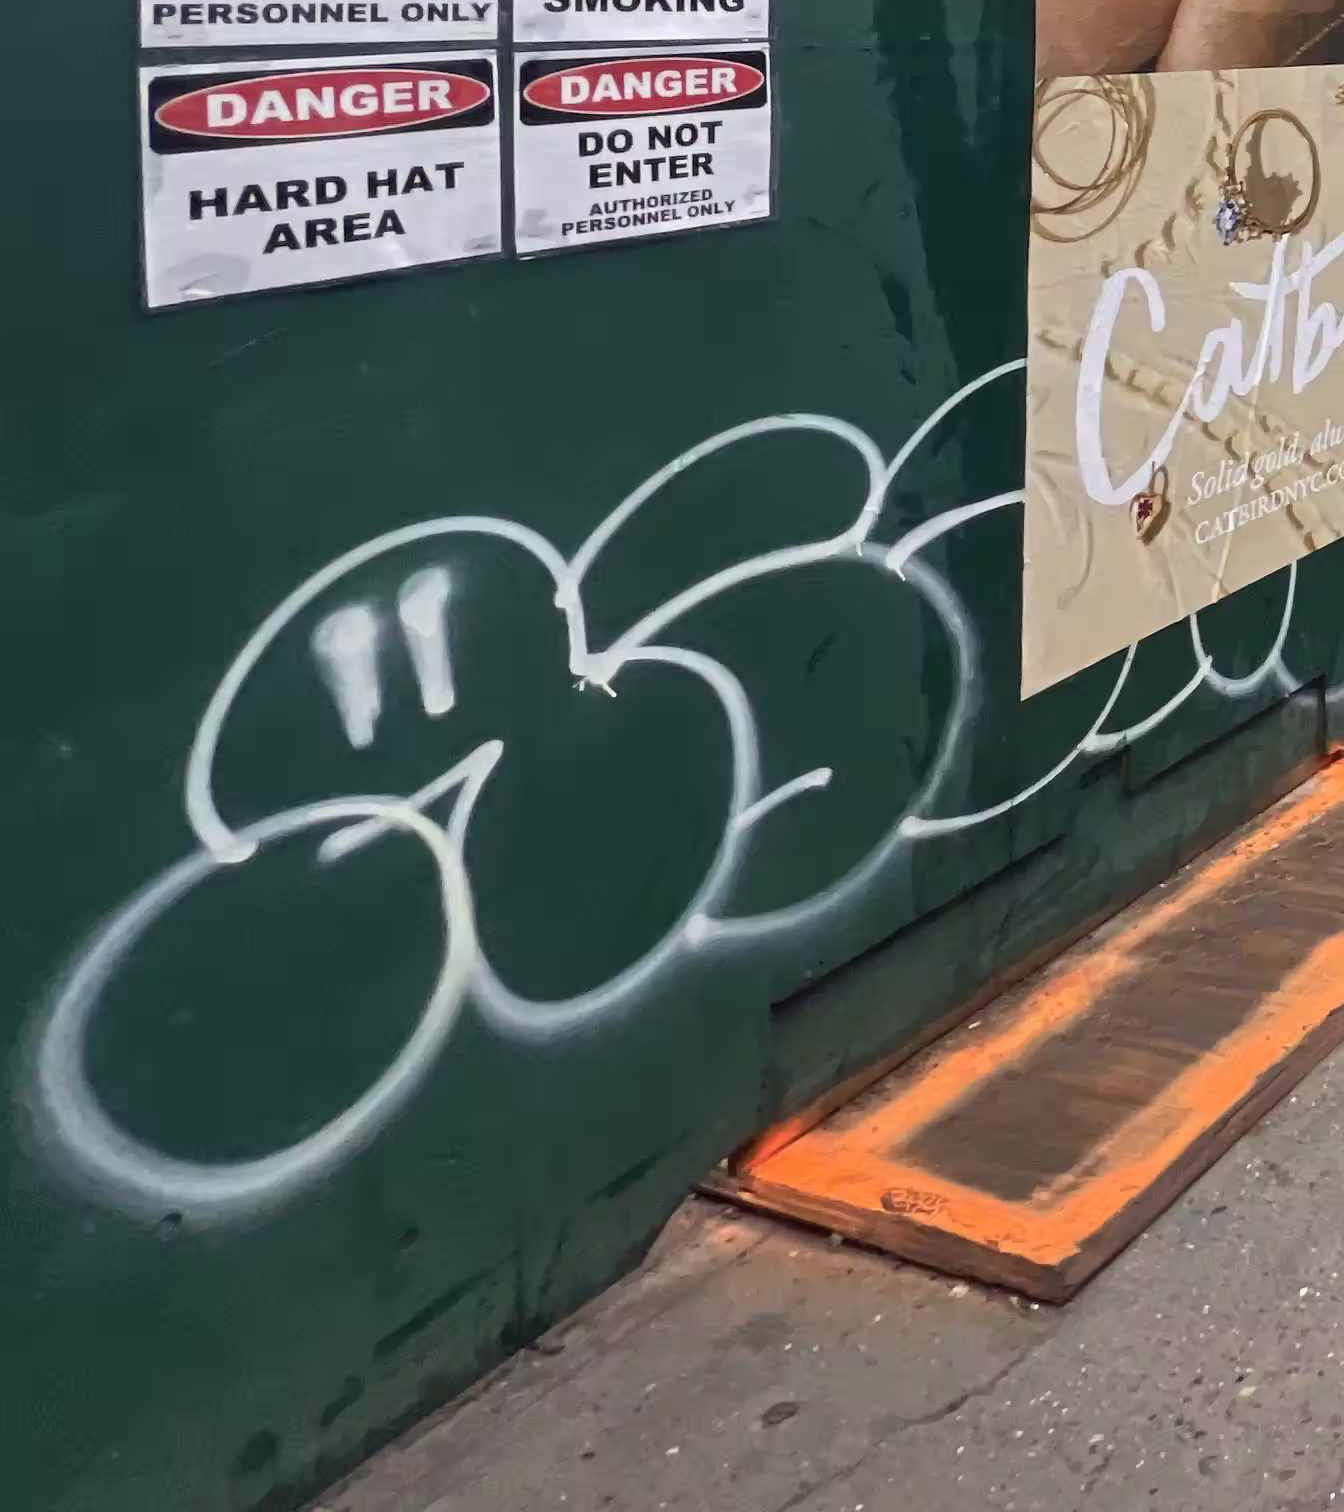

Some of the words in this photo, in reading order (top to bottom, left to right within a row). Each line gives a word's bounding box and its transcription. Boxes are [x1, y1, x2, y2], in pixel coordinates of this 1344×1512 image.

[152, 2, 389, 25] PERSONNEL
[400, 1, 492, 22] ONLY
[206, 79, 453, 128] DANGER
[560, 67, 738, 105] DANGER
[578, 128, 634, 157] DO
[647, 120, 723, 150] NOT
[589, 152, 715, 189] ENTER
[188, 175, 348, 221] HARD
[367, 161, 465, 199] HAT
[588, 188, 713, 216] AUTHORIZED
[262, 209, 406, 255] AREA
[561, 208, 682, 236] PERSONNEL
[686, 199, 736, 218] ONLY
[1186, 451, 1250, 507] Solid
